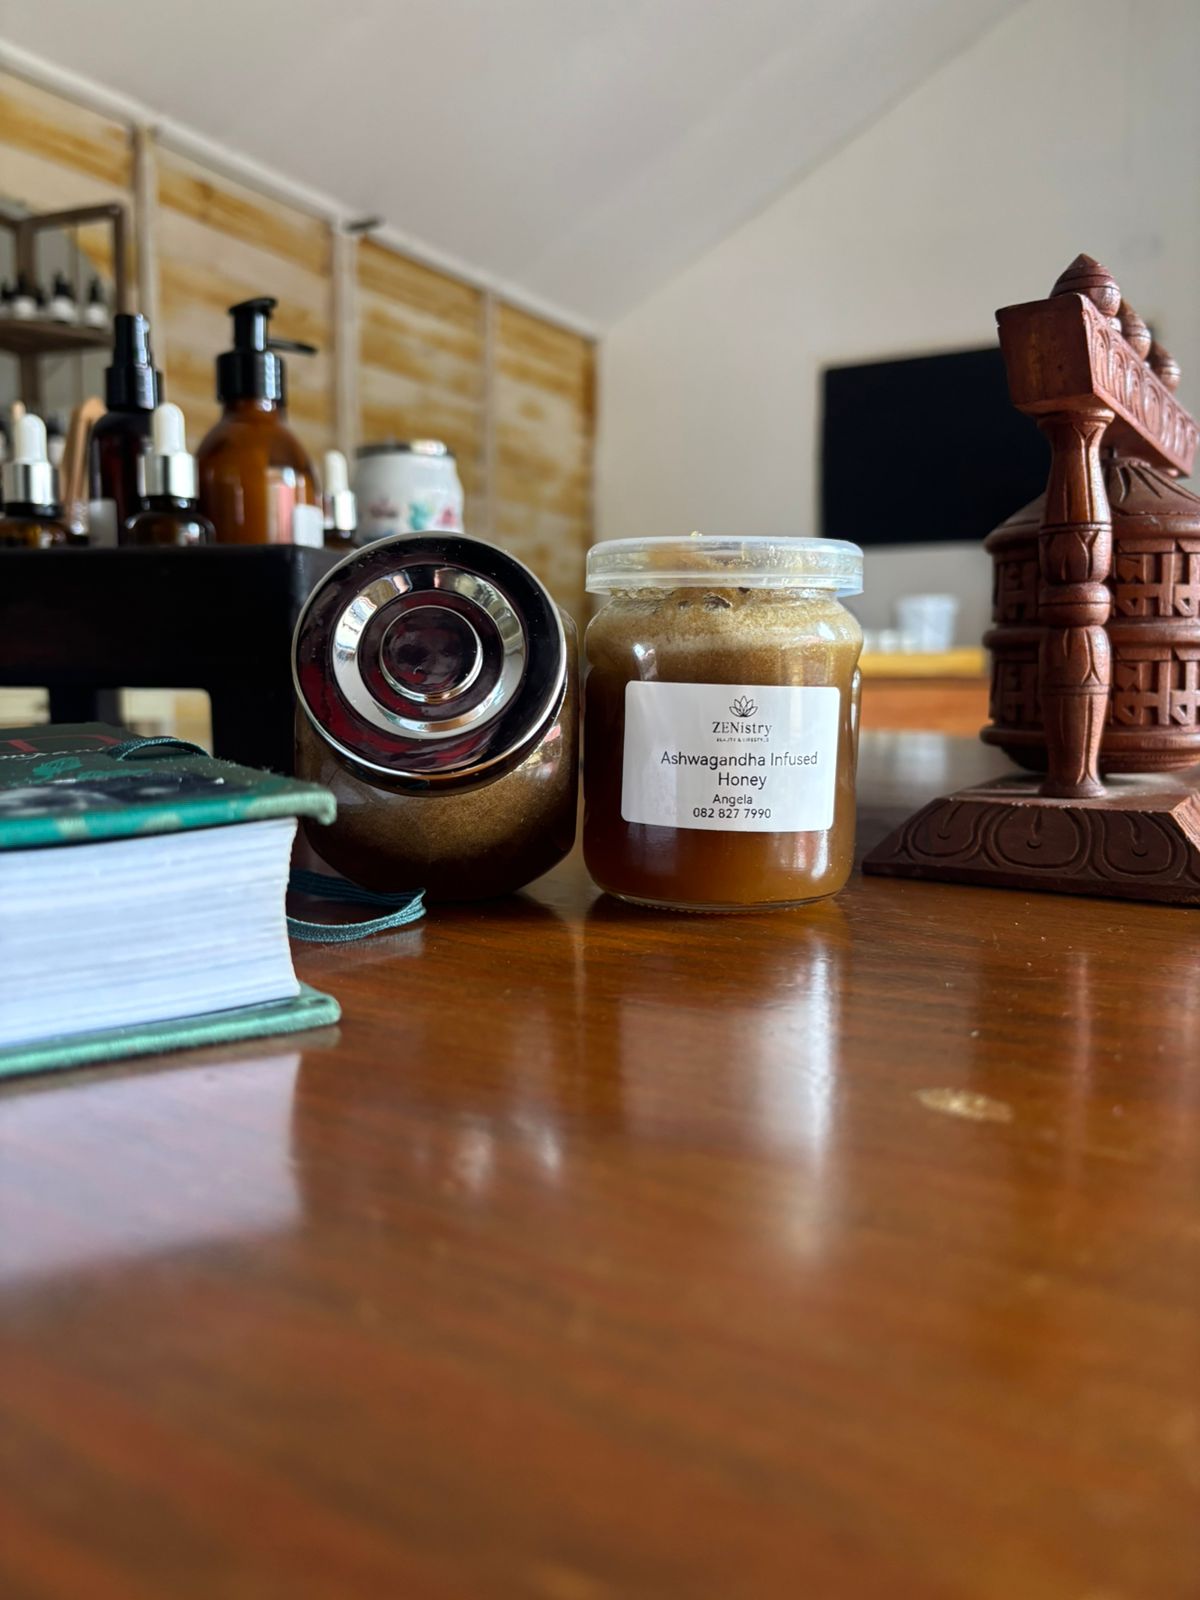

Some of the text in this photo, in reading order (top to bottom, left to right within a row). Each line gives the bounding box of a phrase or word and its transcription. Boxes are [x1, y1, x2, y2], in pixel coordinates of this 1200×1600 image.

[712, 721, 773, 737] ZENistry
[660, 751, 818, 770] Ashwagandha Infused
[718, 772, 767, 790] Honey
[712, 794, 753, 807] Angela
[693, 808, 772, 819] 082 827 7990
